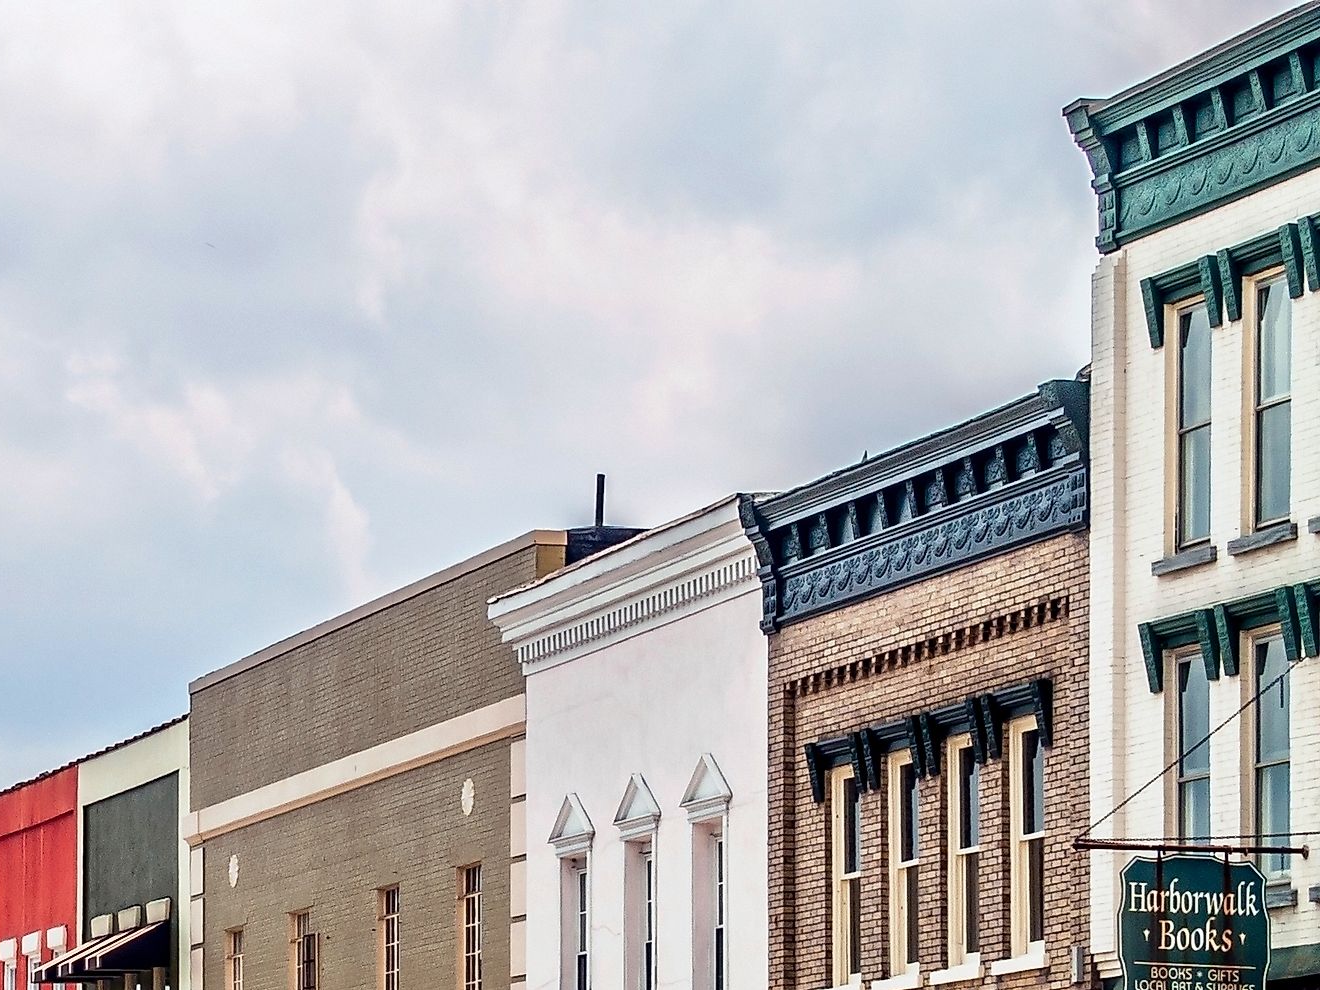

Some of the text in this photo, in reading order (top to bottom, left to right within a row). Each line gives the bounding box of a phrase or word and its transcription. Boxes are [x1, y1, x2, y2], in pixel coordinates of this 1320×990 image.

[1129, 877, 1260, 917] Harborwalk
[1157, 916, 1233, 953] Books
[1150, 966, 1240, 982] BOOKS GIFTS
